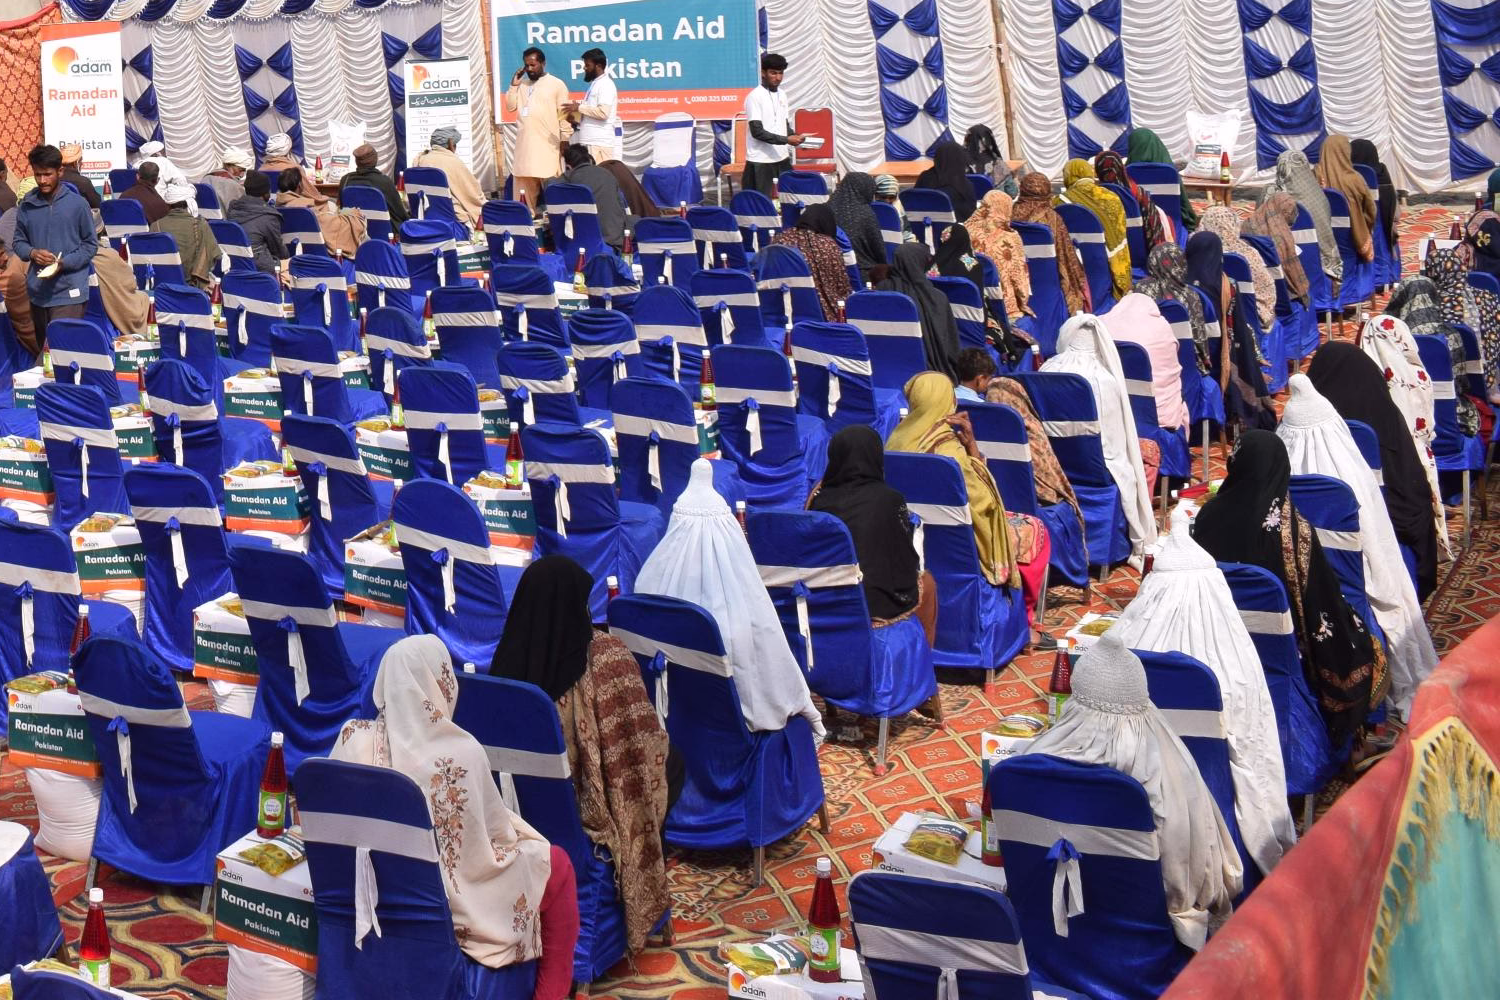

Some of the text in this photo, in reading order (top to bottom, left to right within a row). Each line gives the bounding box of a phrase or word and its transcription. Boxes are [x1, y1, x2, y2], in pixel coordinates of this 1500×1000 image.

[527, 15, 725, 44] Ramadan Aid
[71, 62, 111, 73] adam
[571, 59, 682, 80] Pkistan
[423, 79, 460, 90] adam
[48, 87, 118, 101] Ramadan
[71, 104, 97, 117] Aid
[59, 140, 112, 150] Pistan
[231, 396, 277, 407] Ramadan Aid
[130, 436, 143, 444] Aid
[394, 457, 408, 467] Aid
[25, 469, 39, 478] Aid
[231, 493, 287, 505] Ramadan Aid
[511, 510, 527, 519] Aid
[84, 553, 131, 565] Ramadan
[105, 568, 131, 576] Pakistan
[352, 569, 407, 590] Ramadan Aid
[197, 635, 241, 652] Ramadan
[215, 656, 241, 667] Pakistan
[16, 702, 33, 711] adam
[15, 719, 84, 740] Ramadan Aid
[34, 741, 63, 752] Pakistan
[221, 868, 243, 882] adam
[221, 887, 309, 929] Ramadan Aid
[244, 918, 280, 937] Pakistan
[742, 985, 767, 998] adam
